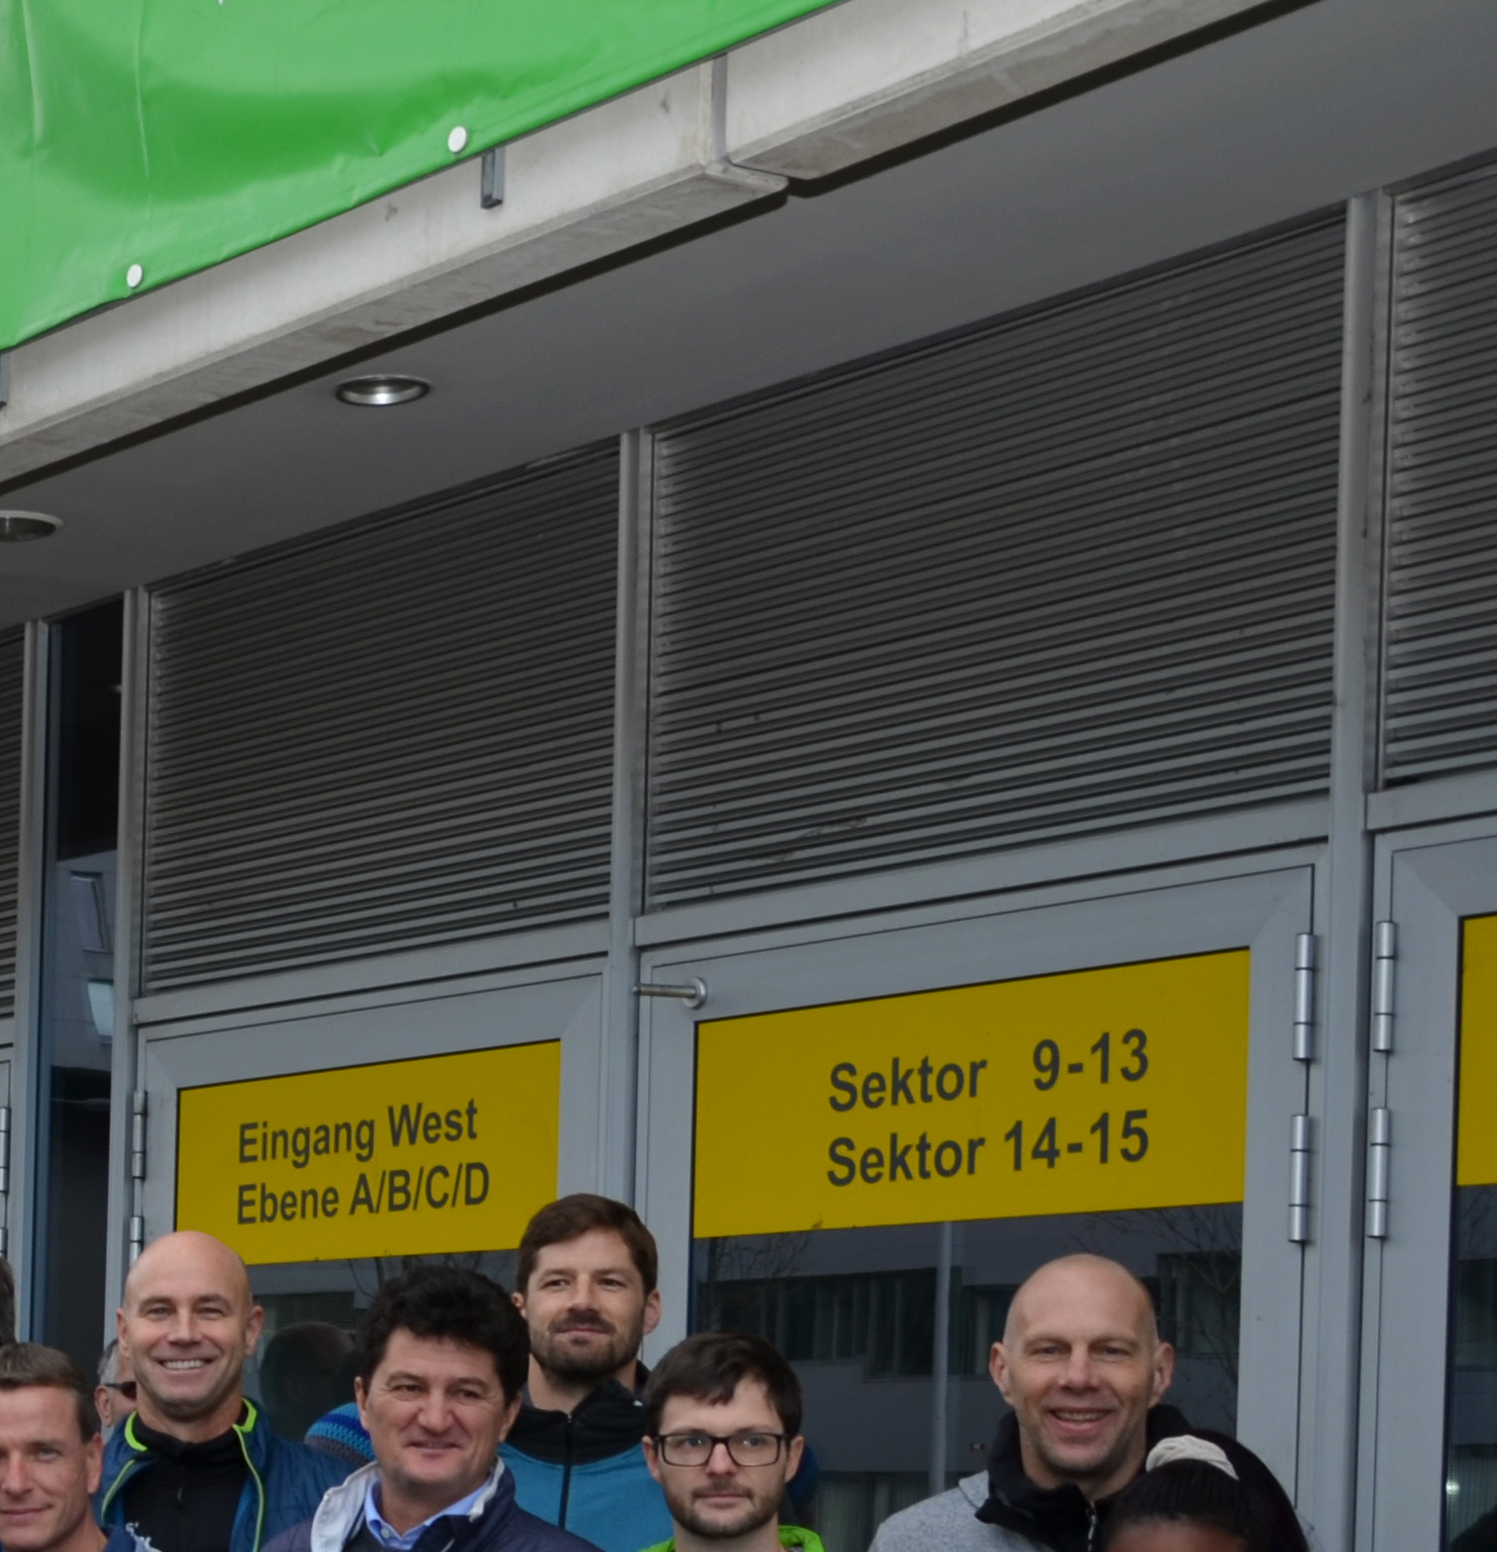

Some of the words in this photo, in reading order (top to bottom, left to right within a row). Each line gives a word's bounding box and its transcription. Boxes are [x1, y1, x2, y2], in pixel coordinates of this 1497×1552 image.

[828, 1054, 988, 1112] Sektor
[1032, 1028, 1149, 1092] 9-13
[238, 1119, 376, 1169] Eingang
[387, 1097, 479, 1148] West
[826, 1130, 987, 1187] Sektor
[1004, 1109, 1149, 1172] 14-15
[237, 1182, 340, 1225] Ebene
[348, 1161, 491, 1216] A/B/C/D
